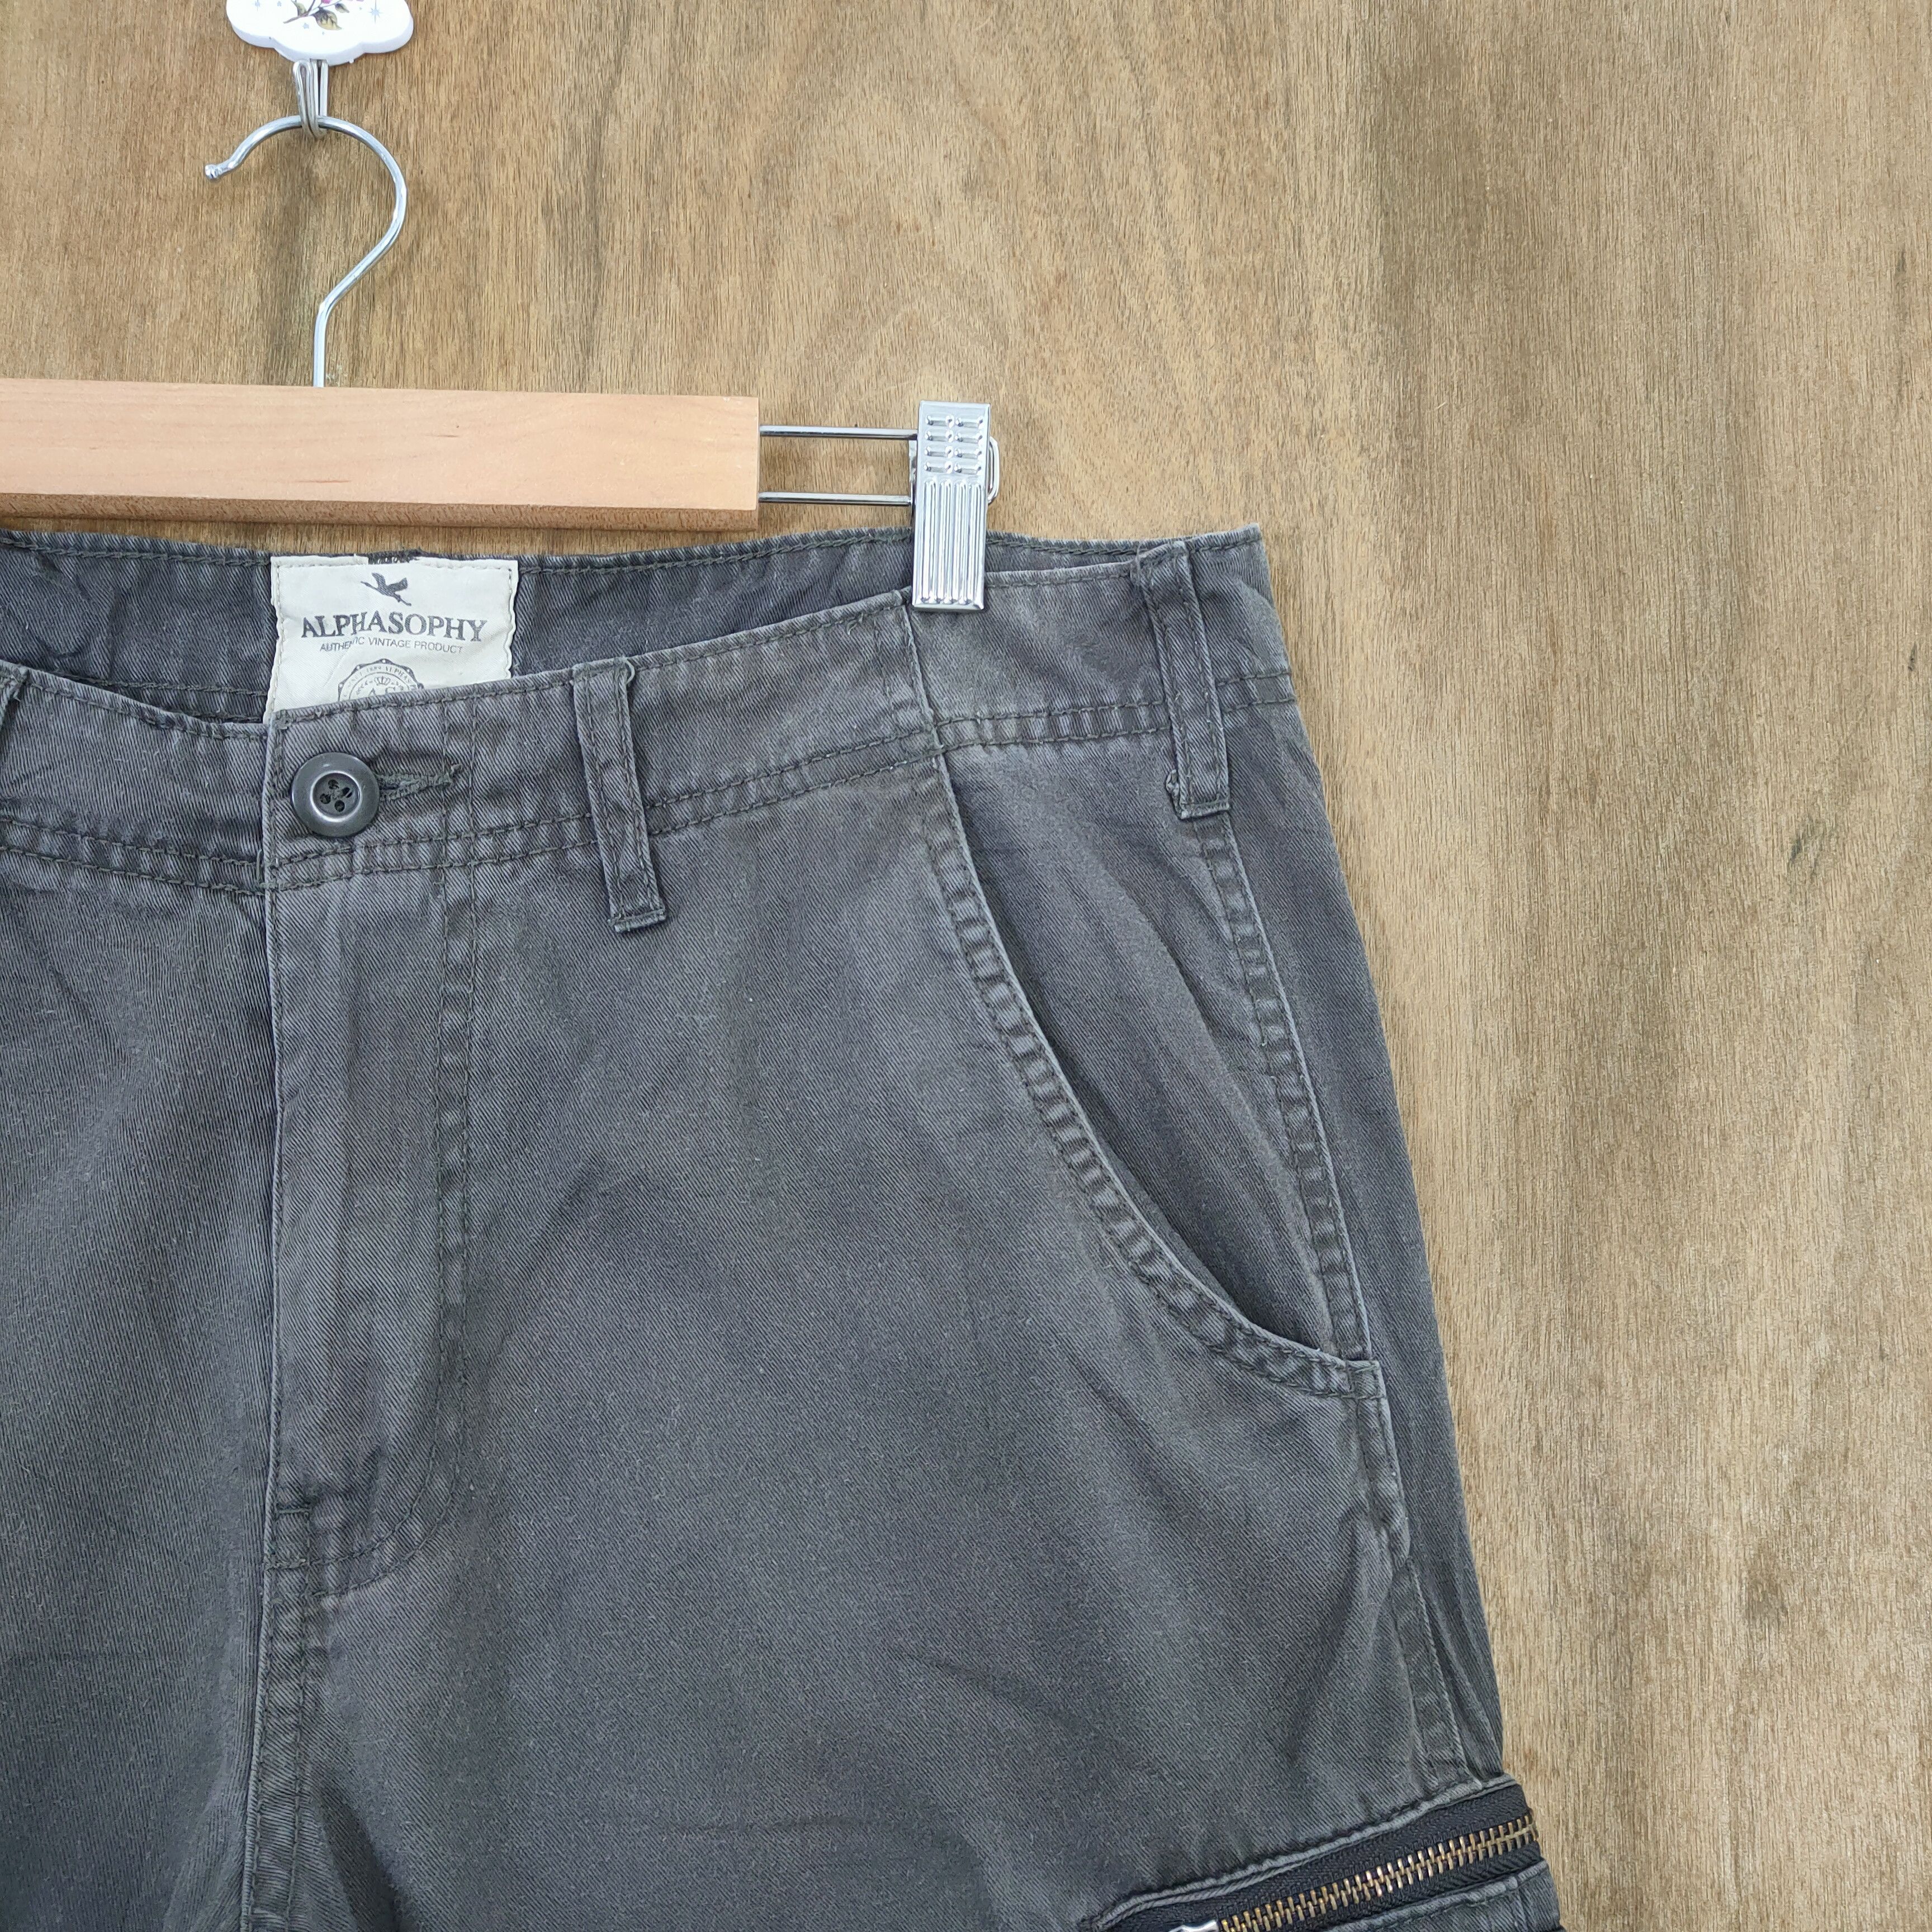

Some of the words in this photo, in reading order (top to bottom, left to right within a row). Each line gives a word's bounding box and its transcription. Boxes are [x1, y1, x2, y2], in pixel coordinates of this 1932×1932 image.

[301, 611, 487, 642] ALPHASOPHY
[368, 637, 411, 648] VINTAGE
[414, 641, 463, 654] PRODUCT
